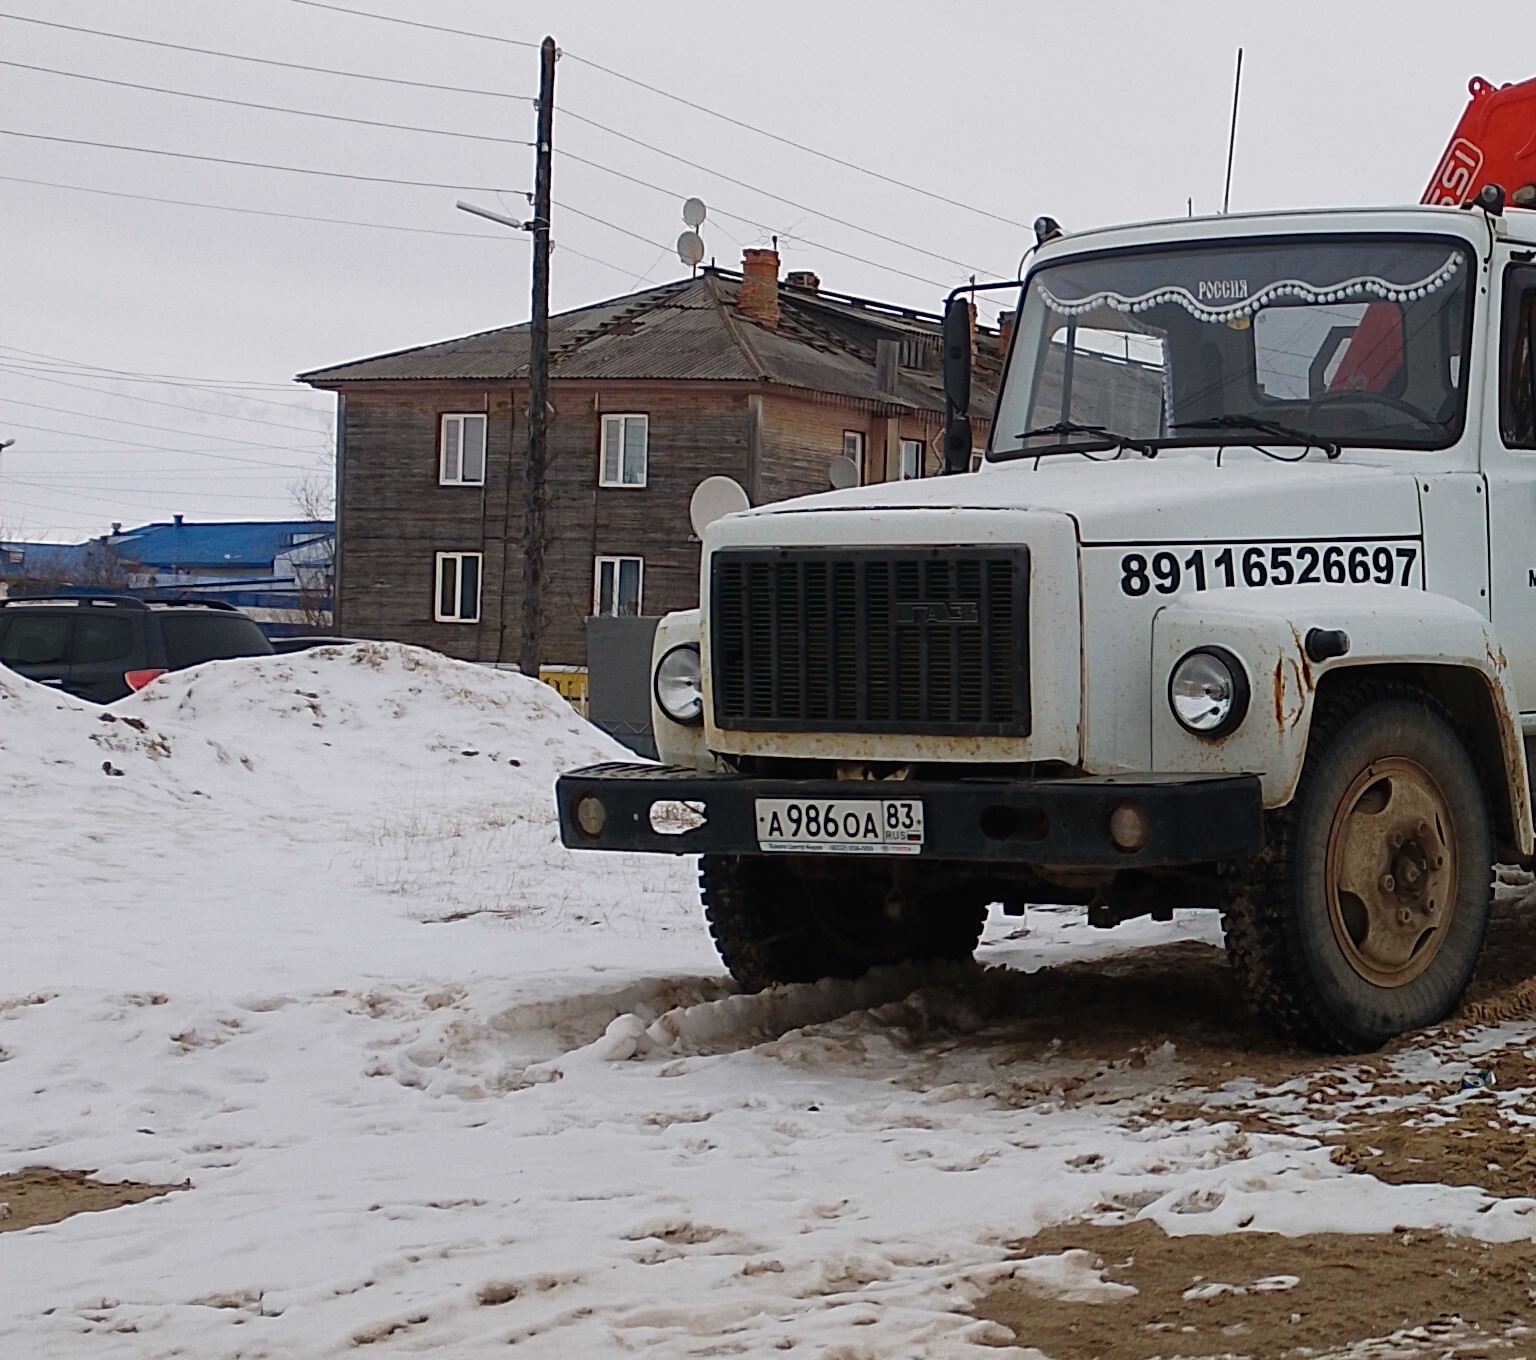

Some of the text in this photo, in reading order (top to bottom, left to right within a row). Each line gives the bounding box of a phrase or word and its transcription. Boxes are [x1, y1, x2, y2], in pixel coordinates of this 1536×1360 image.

[1198, 279, 1248, 300] РОССИЯ
[1121, 546, 1417, 597] 89116526697
[895, 602, 978, 622] ГАЗ
[768, 803, 914, 838] А986ОА 83
[885, 830, 906, 840] RUS
